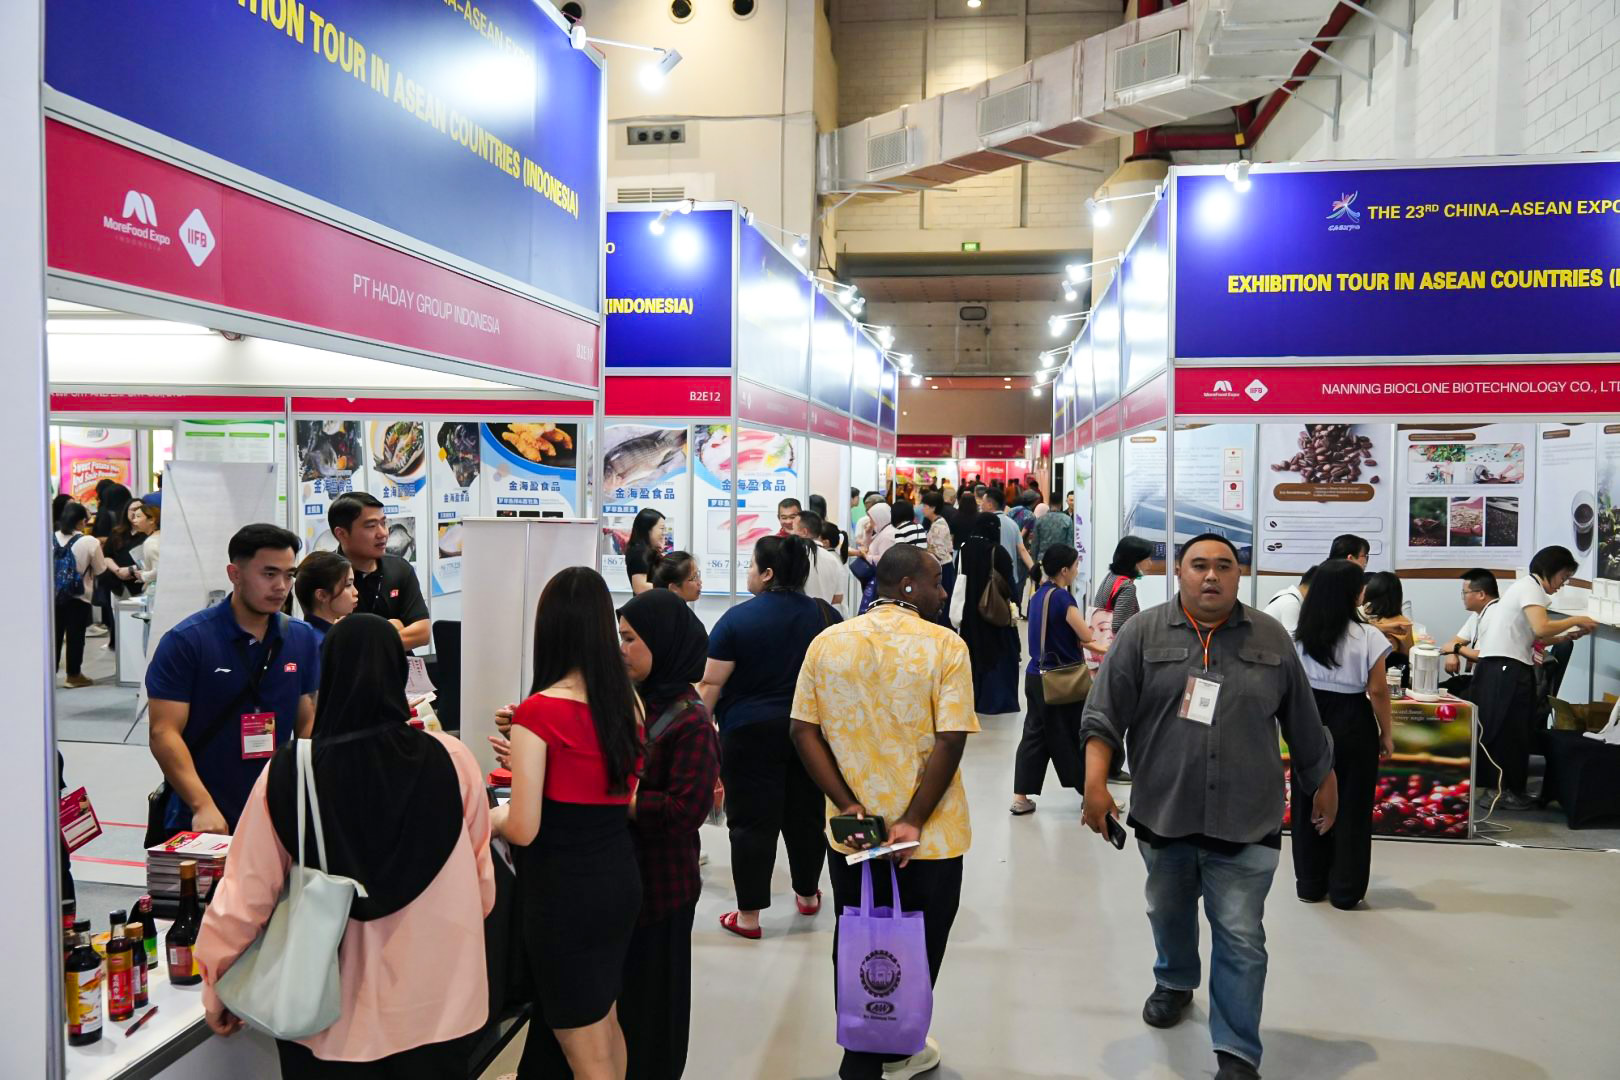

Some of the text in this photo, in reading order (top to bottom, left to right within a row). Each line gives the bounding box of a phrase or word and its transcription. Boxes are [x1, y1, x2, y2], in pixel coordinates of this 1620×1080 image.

[310, 10, 366, 83] TOUR
[371, 53, 390, 98] IN
[394, 71, 446, 133] ASEAN
[450, 111, 520, 179] COUNTRIES
[523, 157, 579, 220] (INDONESIA)
[1367, 205, 1400, 219] THE
[103, 215, 171, 246] MoreFood Expo
[187, 227, 207, 248] IIFB
[1227, 274, 1332, 293] EXHIBITION
[1336, 273, 1389, 291] TOUR
[1394, 272, 1414, 290] IN
[1419, 271, 1486, 290] ASEAN
[1490, 269, 1603, 289] COUNTRIES
[353, 274, 500, 334] PT HADAY GROUP INDONESIA
[604, 298, 694, 315] (INDONESIA)
[690, 391, 720, 402] B2E12
[1322, 383, 1381, 395] NANNING
[1384, 382, 1450, 394] BIOCLONE
[1452, 381, 1566, 394] BIOTECHNOLOGY
[1570, 381, 1597, 394] CO.,
[508, 480, 560, 491] 金海盈食品
[616, 487, 675, 499] 金海盈食品
